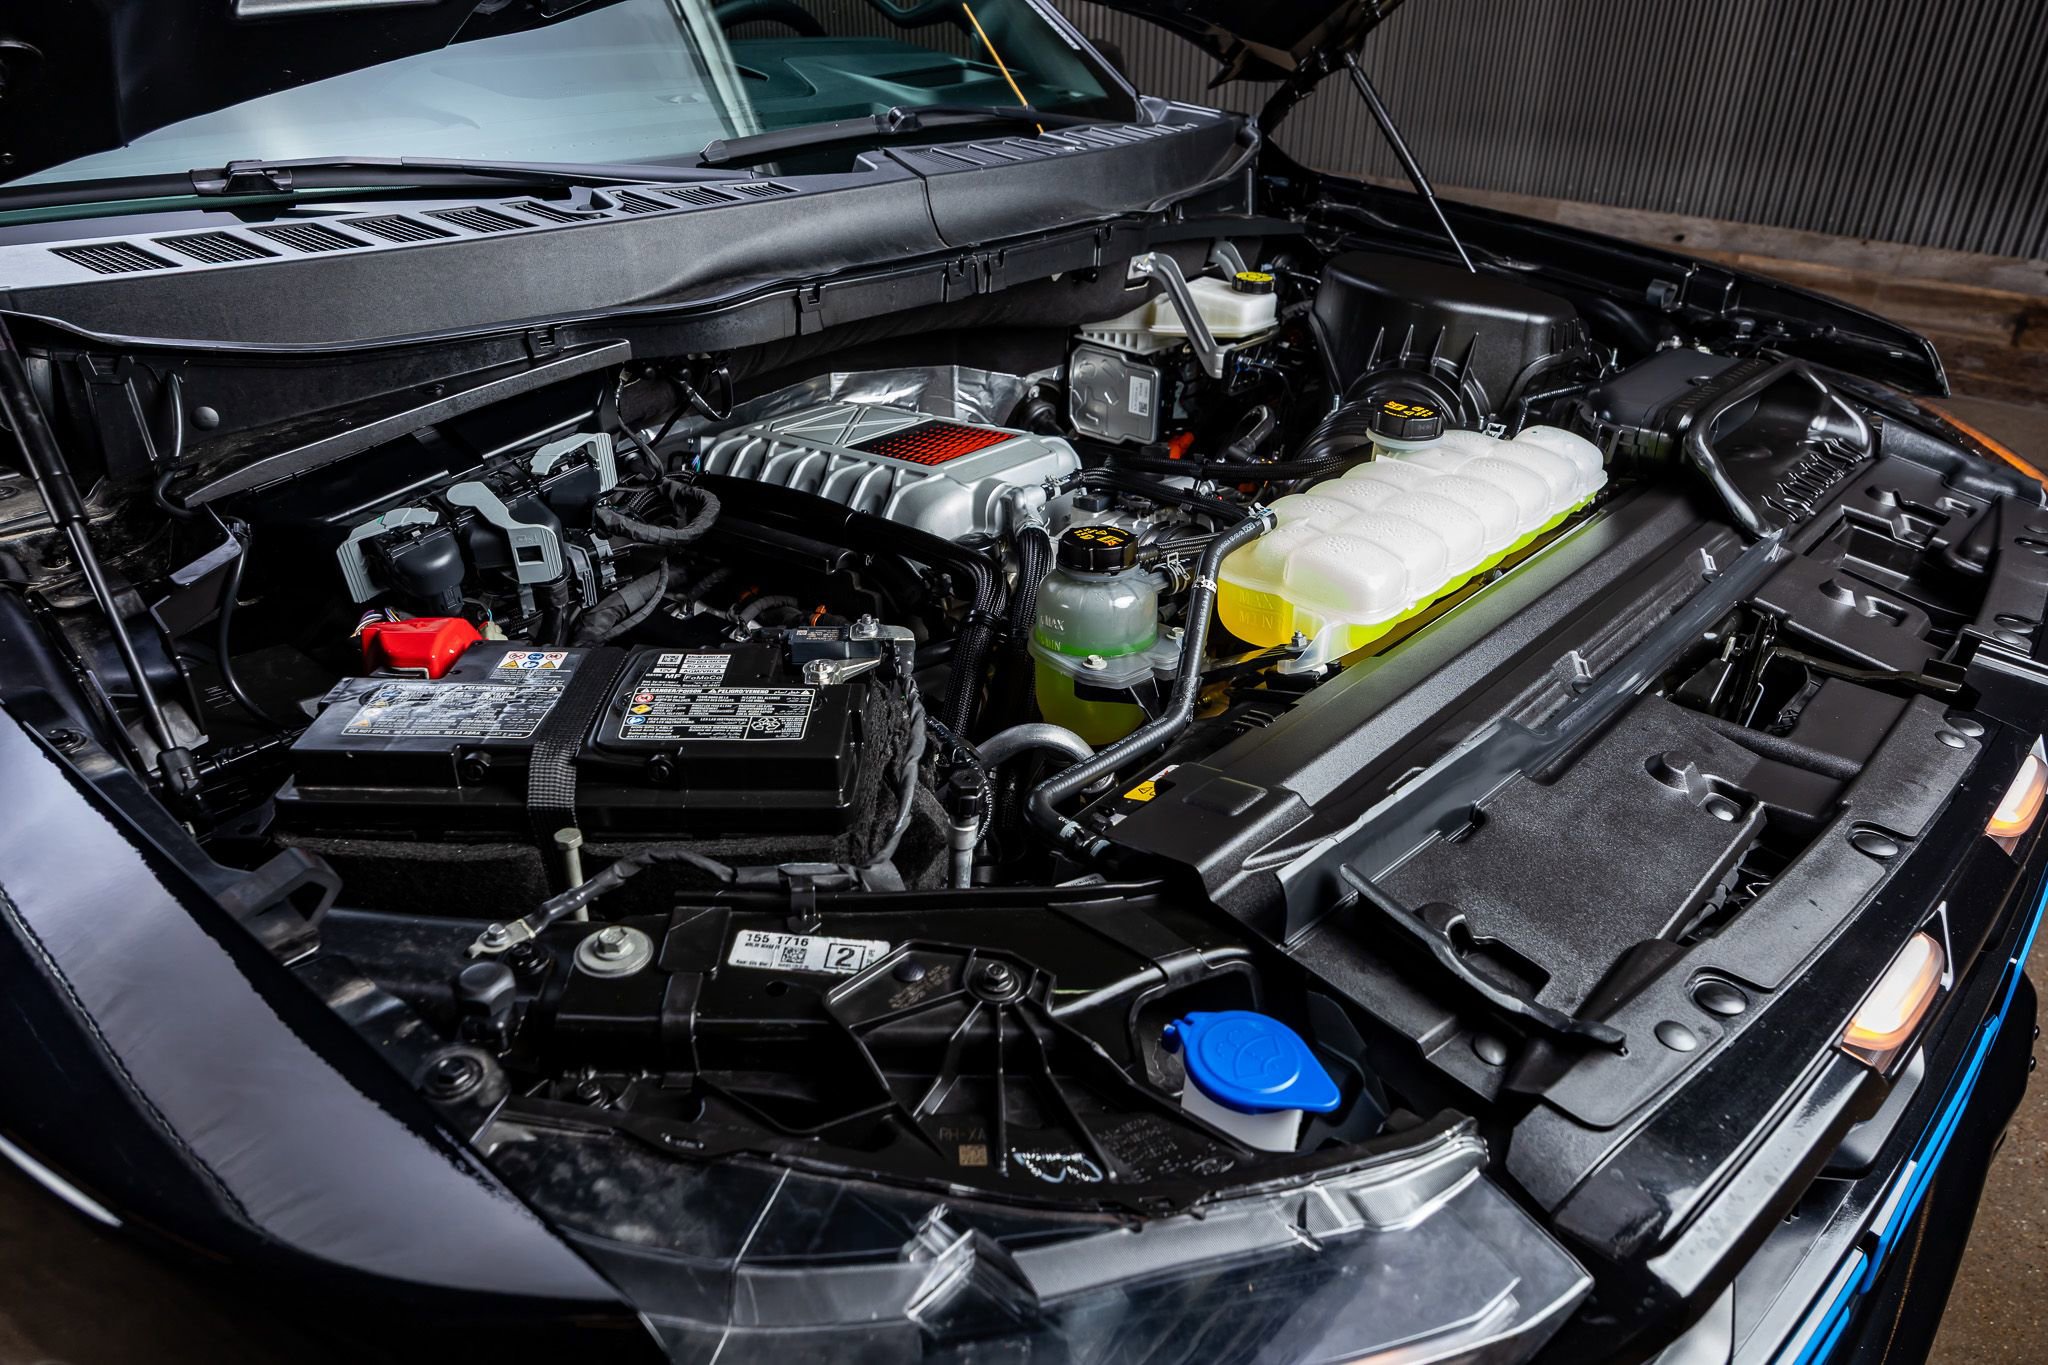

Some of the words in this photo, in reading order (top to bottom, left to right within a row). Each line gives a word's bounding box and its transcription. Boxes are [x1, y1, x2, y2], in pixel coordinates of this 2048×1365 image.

[1239, 591, 1273, 610] MAX
[1044, 615, 1064, 631] MAX
[1239, 611, 1273, 630] MIN
[747, 933, 770, 943] 155
[777, 936, 809, 947] 1716
[834, 947, 856, 967] 2
